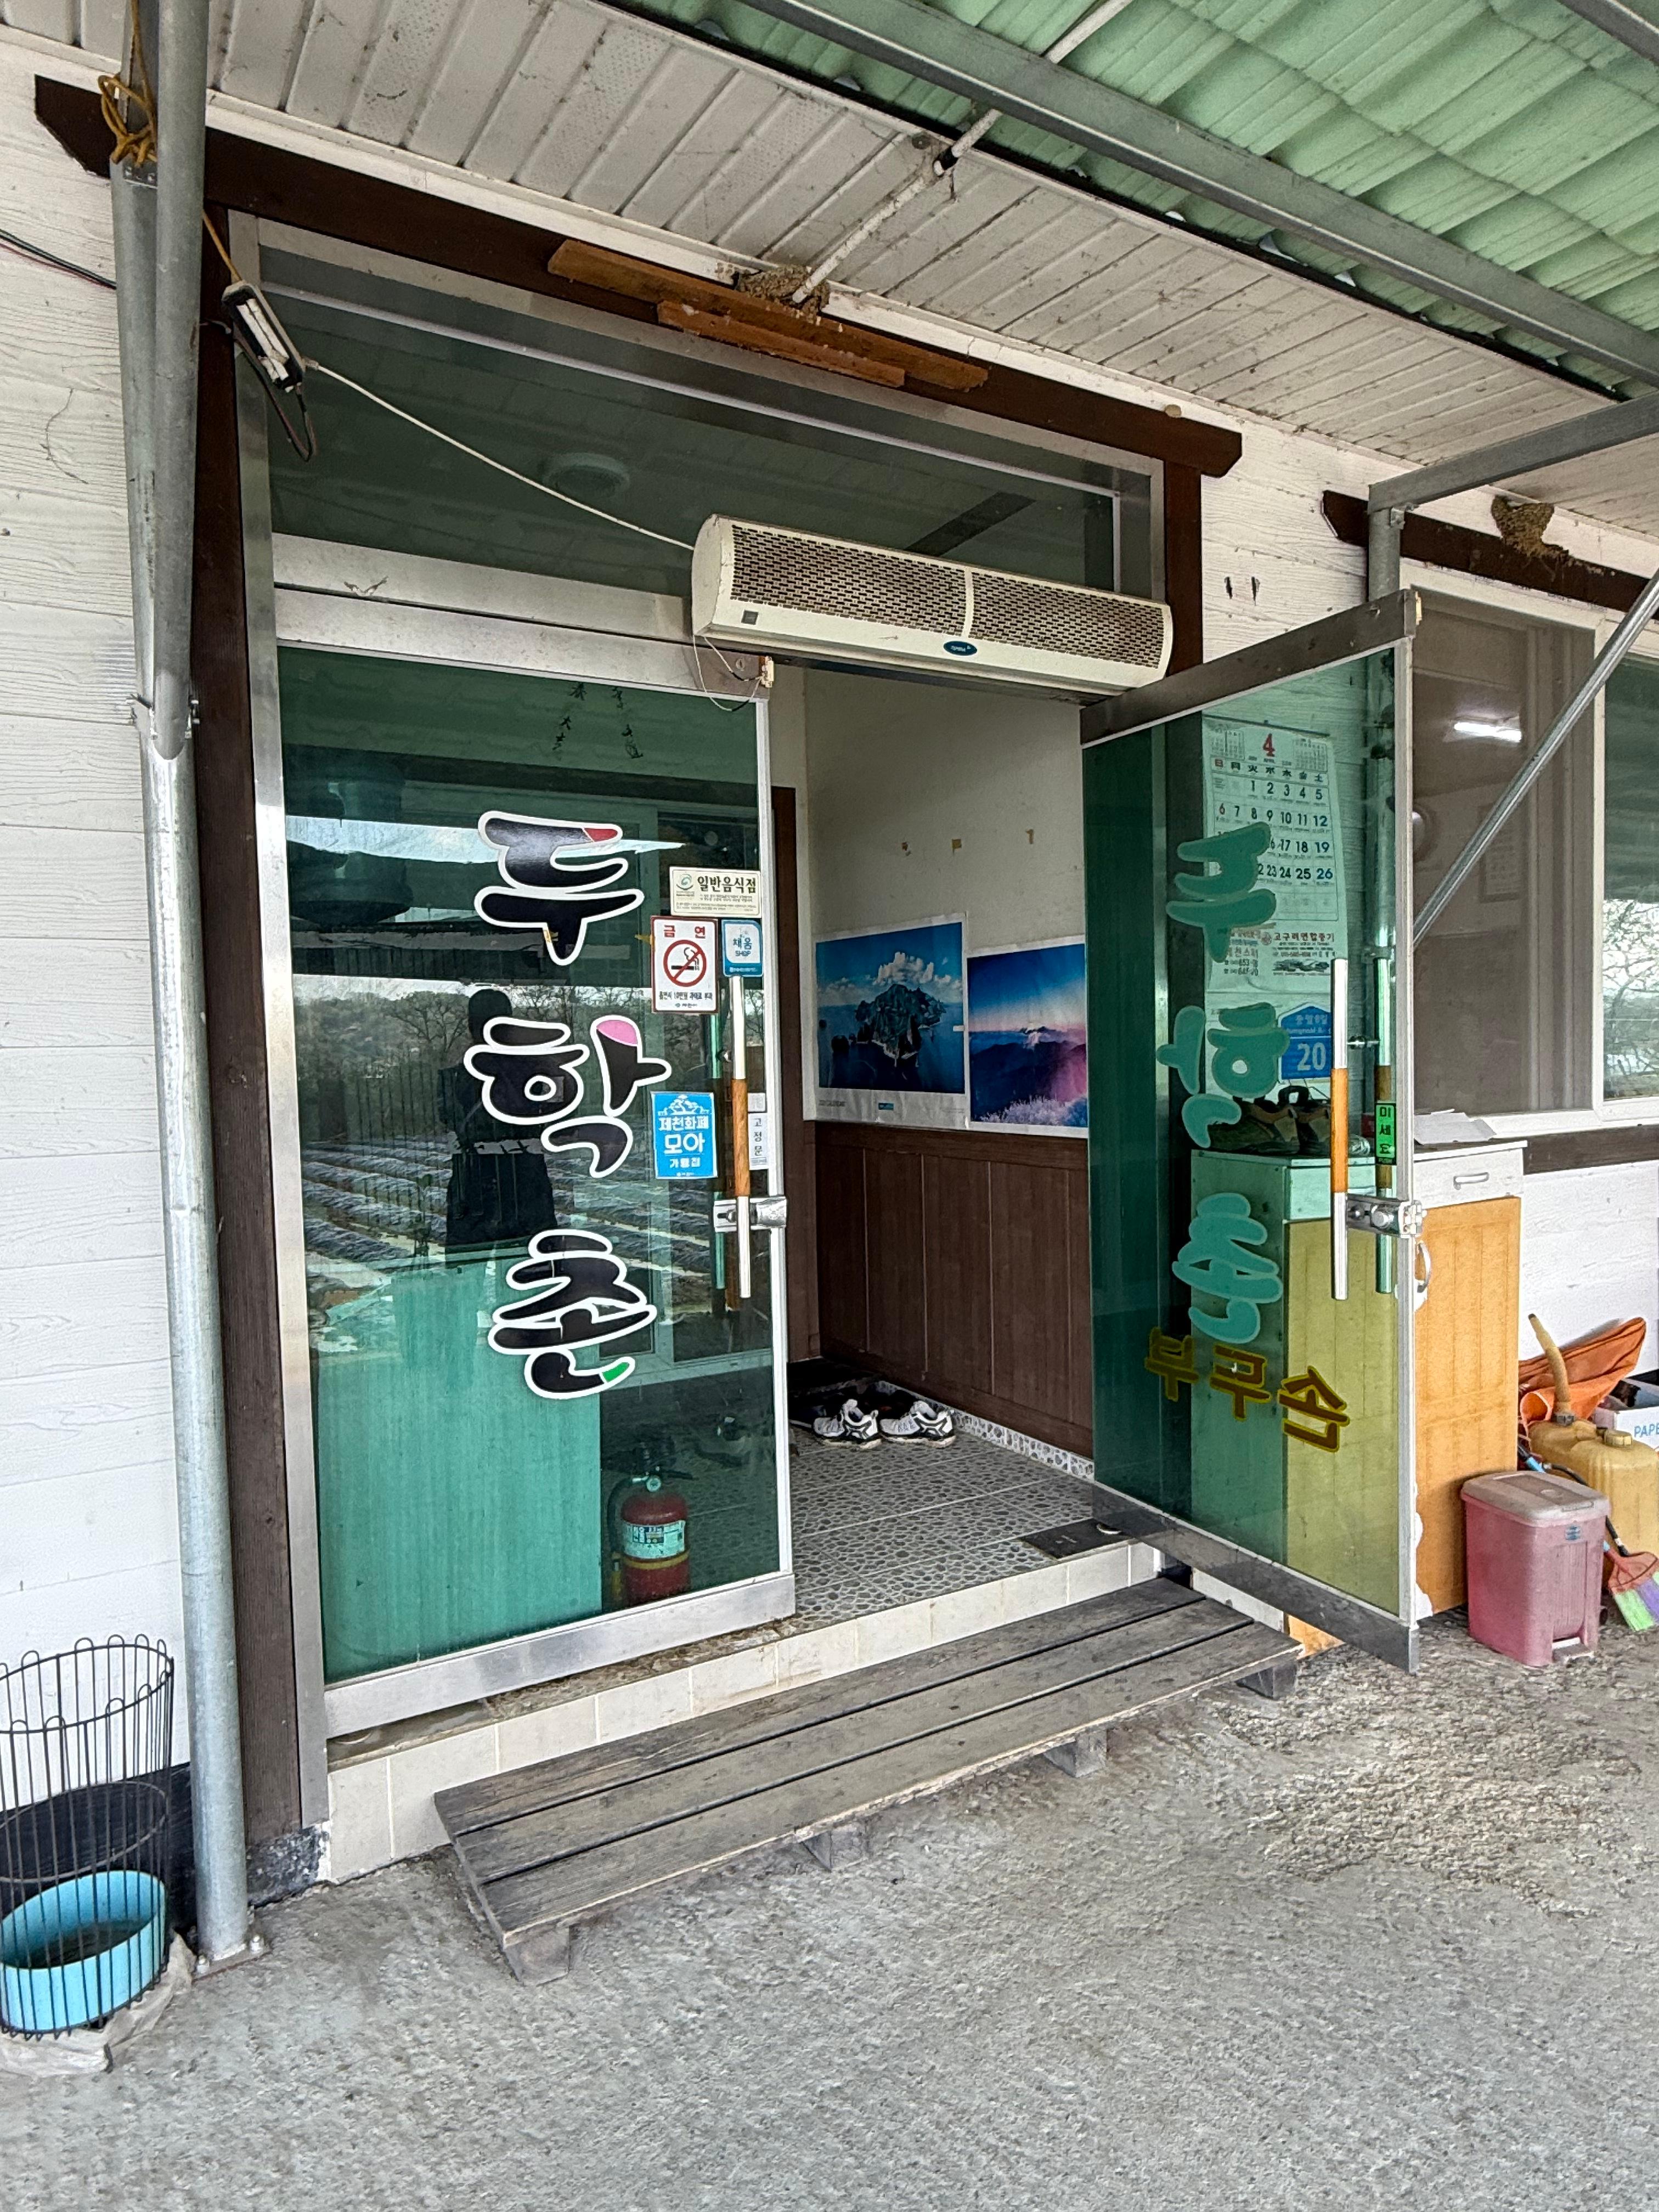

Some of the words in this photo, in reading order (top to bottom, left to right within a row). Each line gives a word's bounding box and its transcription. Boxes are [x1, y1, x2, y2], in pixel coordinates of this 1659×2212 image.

[1263, 733, 1275, 757] 4
[1282, 769, 1292, 777] 木
[1314, 772, 1323, 783] 土
[1251, 780, 1255, 792] 1
[1267, 781, 1274, 794] 2
[1283, 784, 1290, 797] 3
[1299, 787, 1306, 799] 4
[1316, 788, 1323, 800] 5
[1219, 803, 1226, 815] 6
[1234, 805, 1240, 817] 7
[1251, 807, 1257, 820] 8
[1266, 810, 1273, 821] 9
[1280, 811, 1292, 824] 10
[1297, 813, 1307, 826] 11
[1313, 815, 1328, 827] 12
[1280, 839, 1290, 851] 17
[1296, 841, 1308, 853] 18
[1315, 842, 1330, 853] 19
[1266, 865, 1277, 877] 23
[1279, 867, 1291, 878] 24
[1295, 868, 1311, 879] 25
[1316, 868, 1333, 879] 26
[697, 875, 757, 894] 일반음식점
[1297, 1042, 1327, 1071] 20
[1379, 1106, 1391, 1154] 미세요
[664, 1132, 706, 1155] 모아
